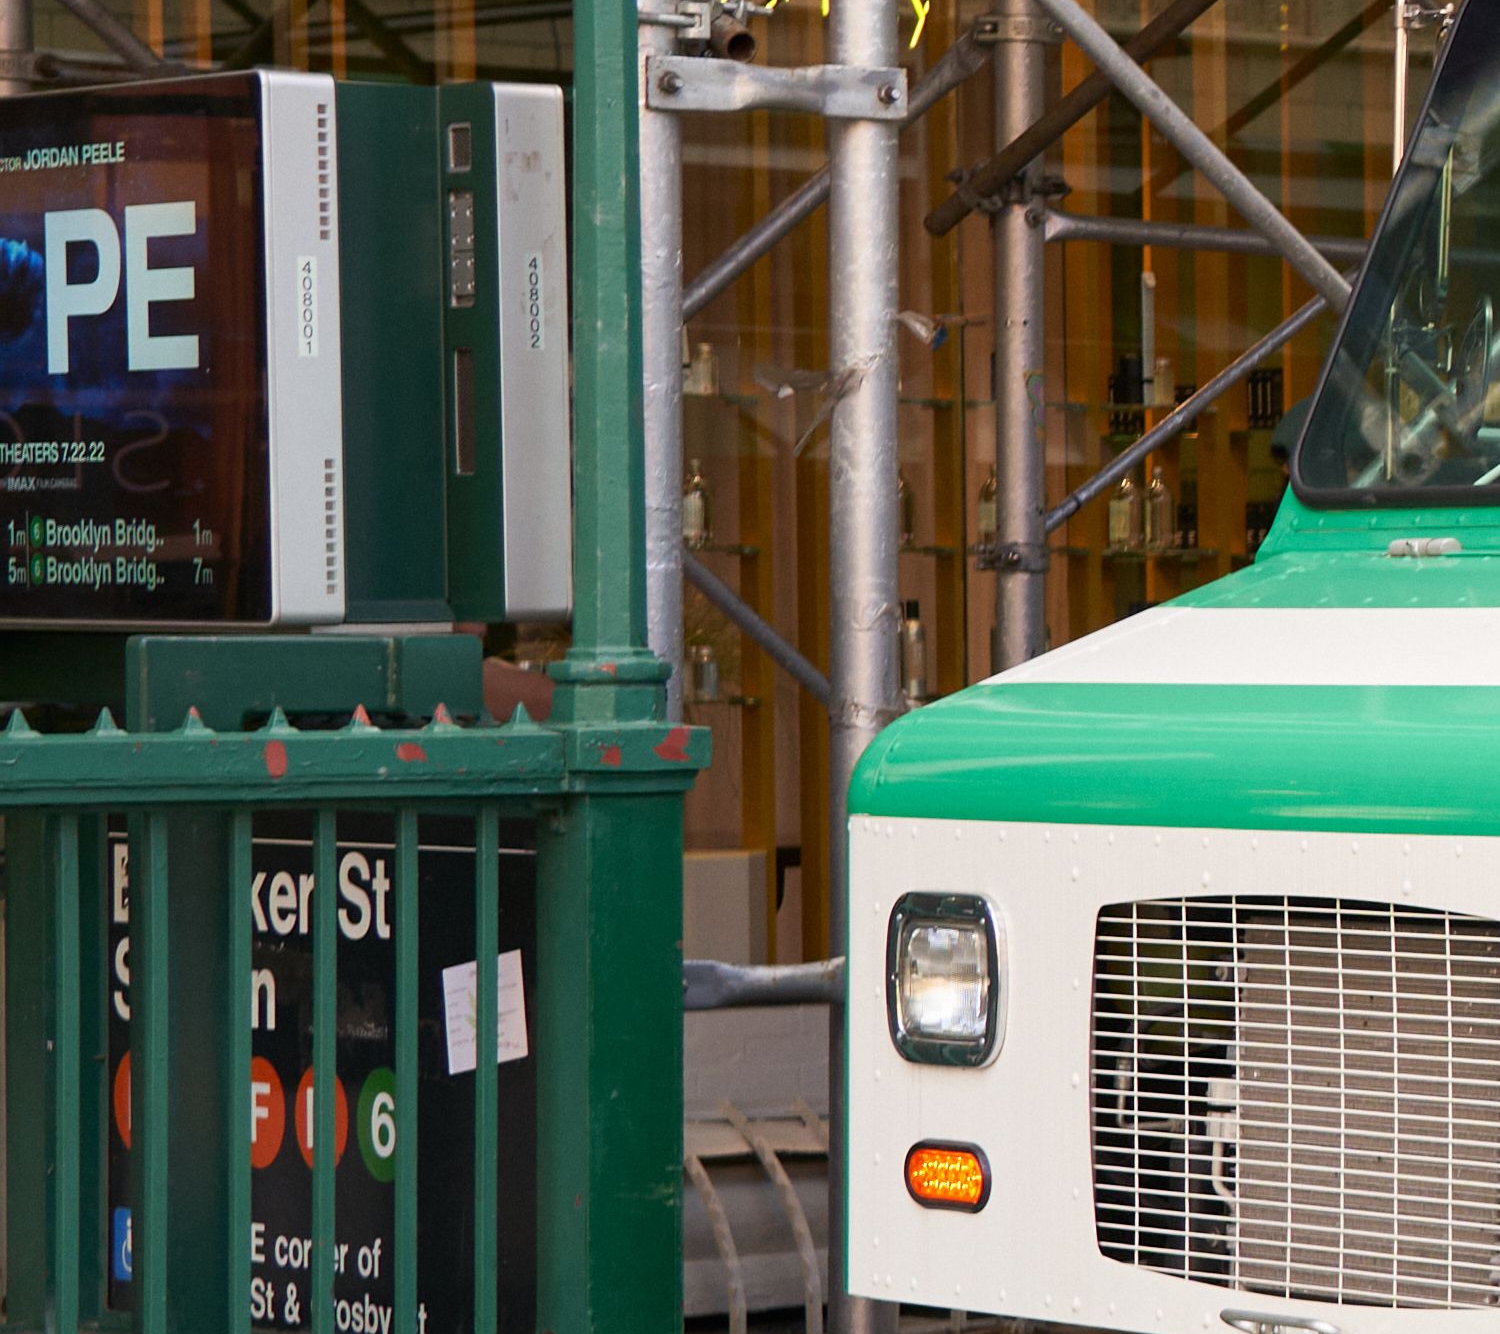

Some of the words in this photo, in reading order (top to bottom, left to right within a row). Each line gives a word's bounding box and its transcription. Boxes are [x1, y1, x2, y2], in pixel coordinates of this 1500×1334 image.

[24, 146, 79, 171] JORDAN
[82, 141, 125, 165] PEELE
[301, 260, 313, 354] 408001
[528, 257, 541, 349] 408002
[61, 441, 105, 463] 7.22.22
[46, 518, 111, 553] Brooklyn
[46, 556, 112, 591] Brooklyn
[337, 850, 391, 941] St
[371, 1091, 396, 1159] 6
[274, 1234, 349, 1275] corer
[357, 1238, 382, 1279] of
[250, 1276, 275, 1320] St
[284, 1283, 301, 1324] &
